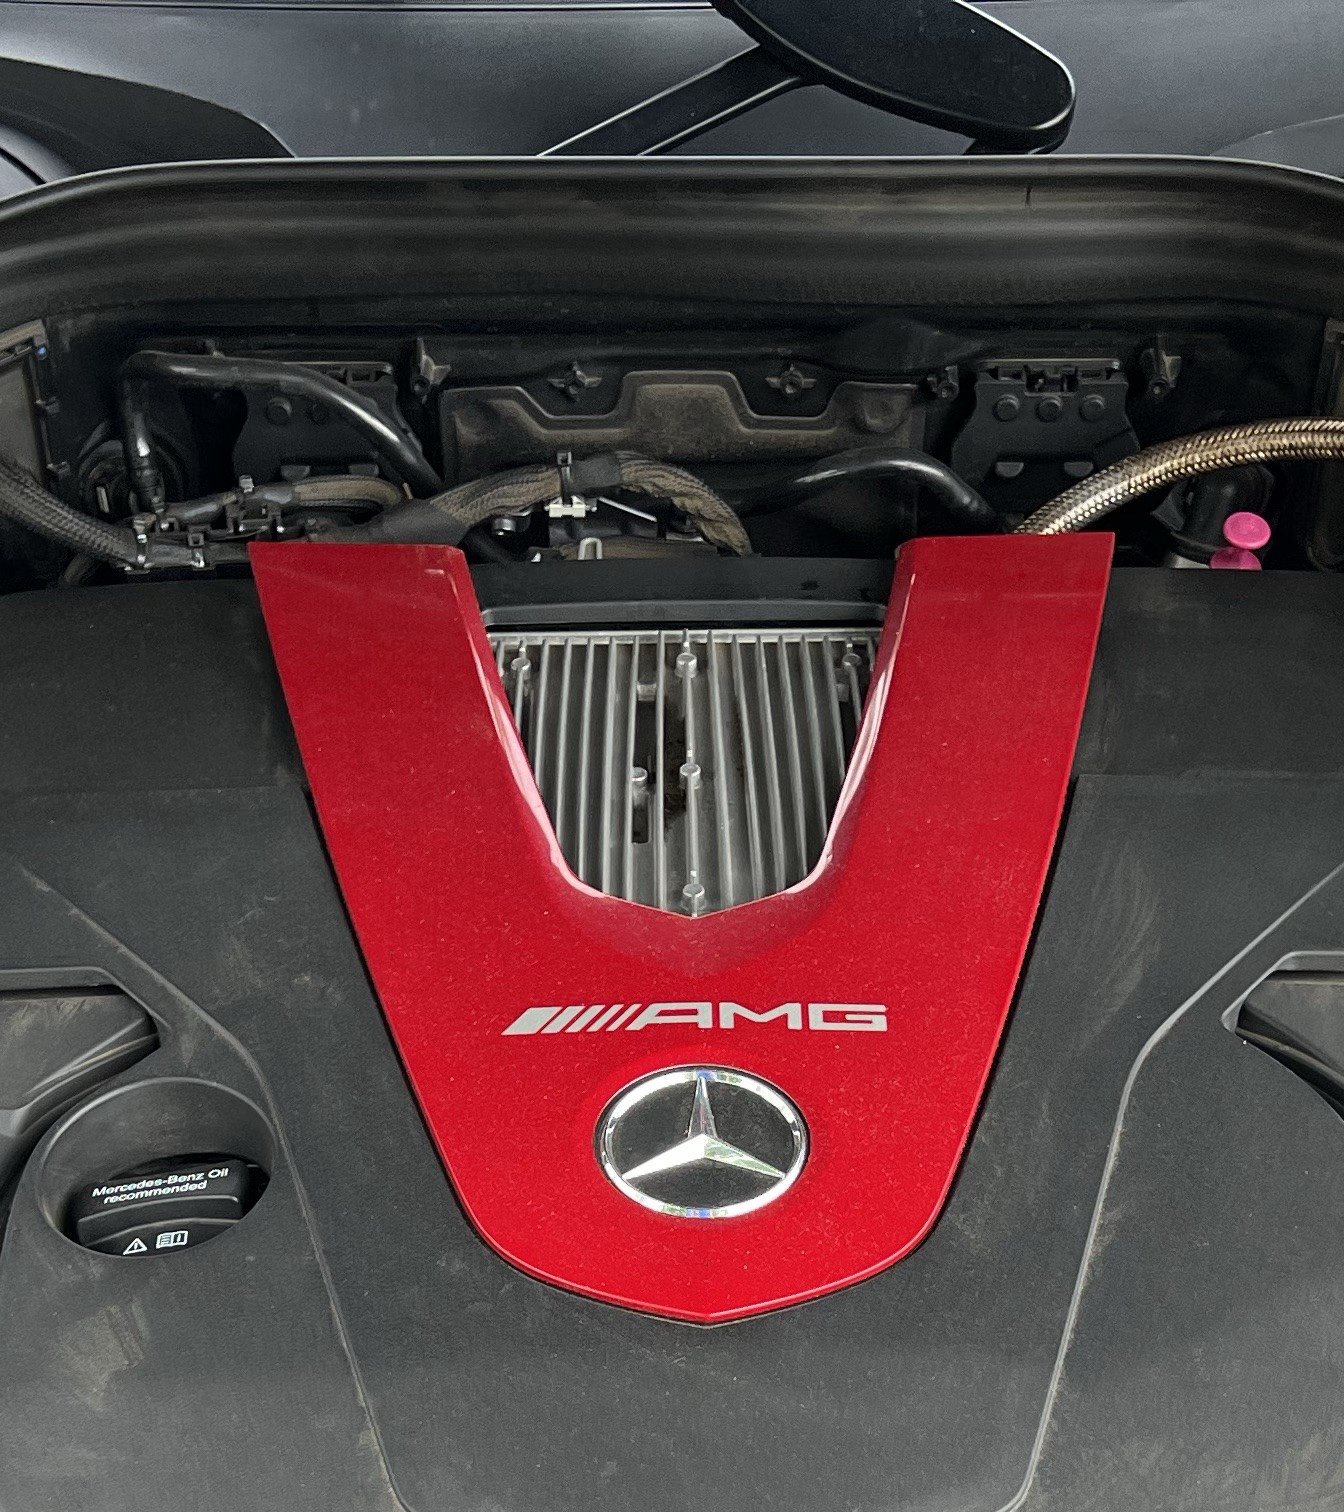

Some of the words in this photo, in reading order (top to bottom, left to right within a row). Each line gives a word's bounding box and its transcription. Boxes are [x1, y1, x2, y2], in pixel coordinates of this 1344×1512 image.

[627, 1002, 888, 1032] AMG
[92, 1171, 205, 1198] Mercedes-Benz
[208, 1167, 229, 1179] Oil
[103, 1180, 207, 1204] recommended
